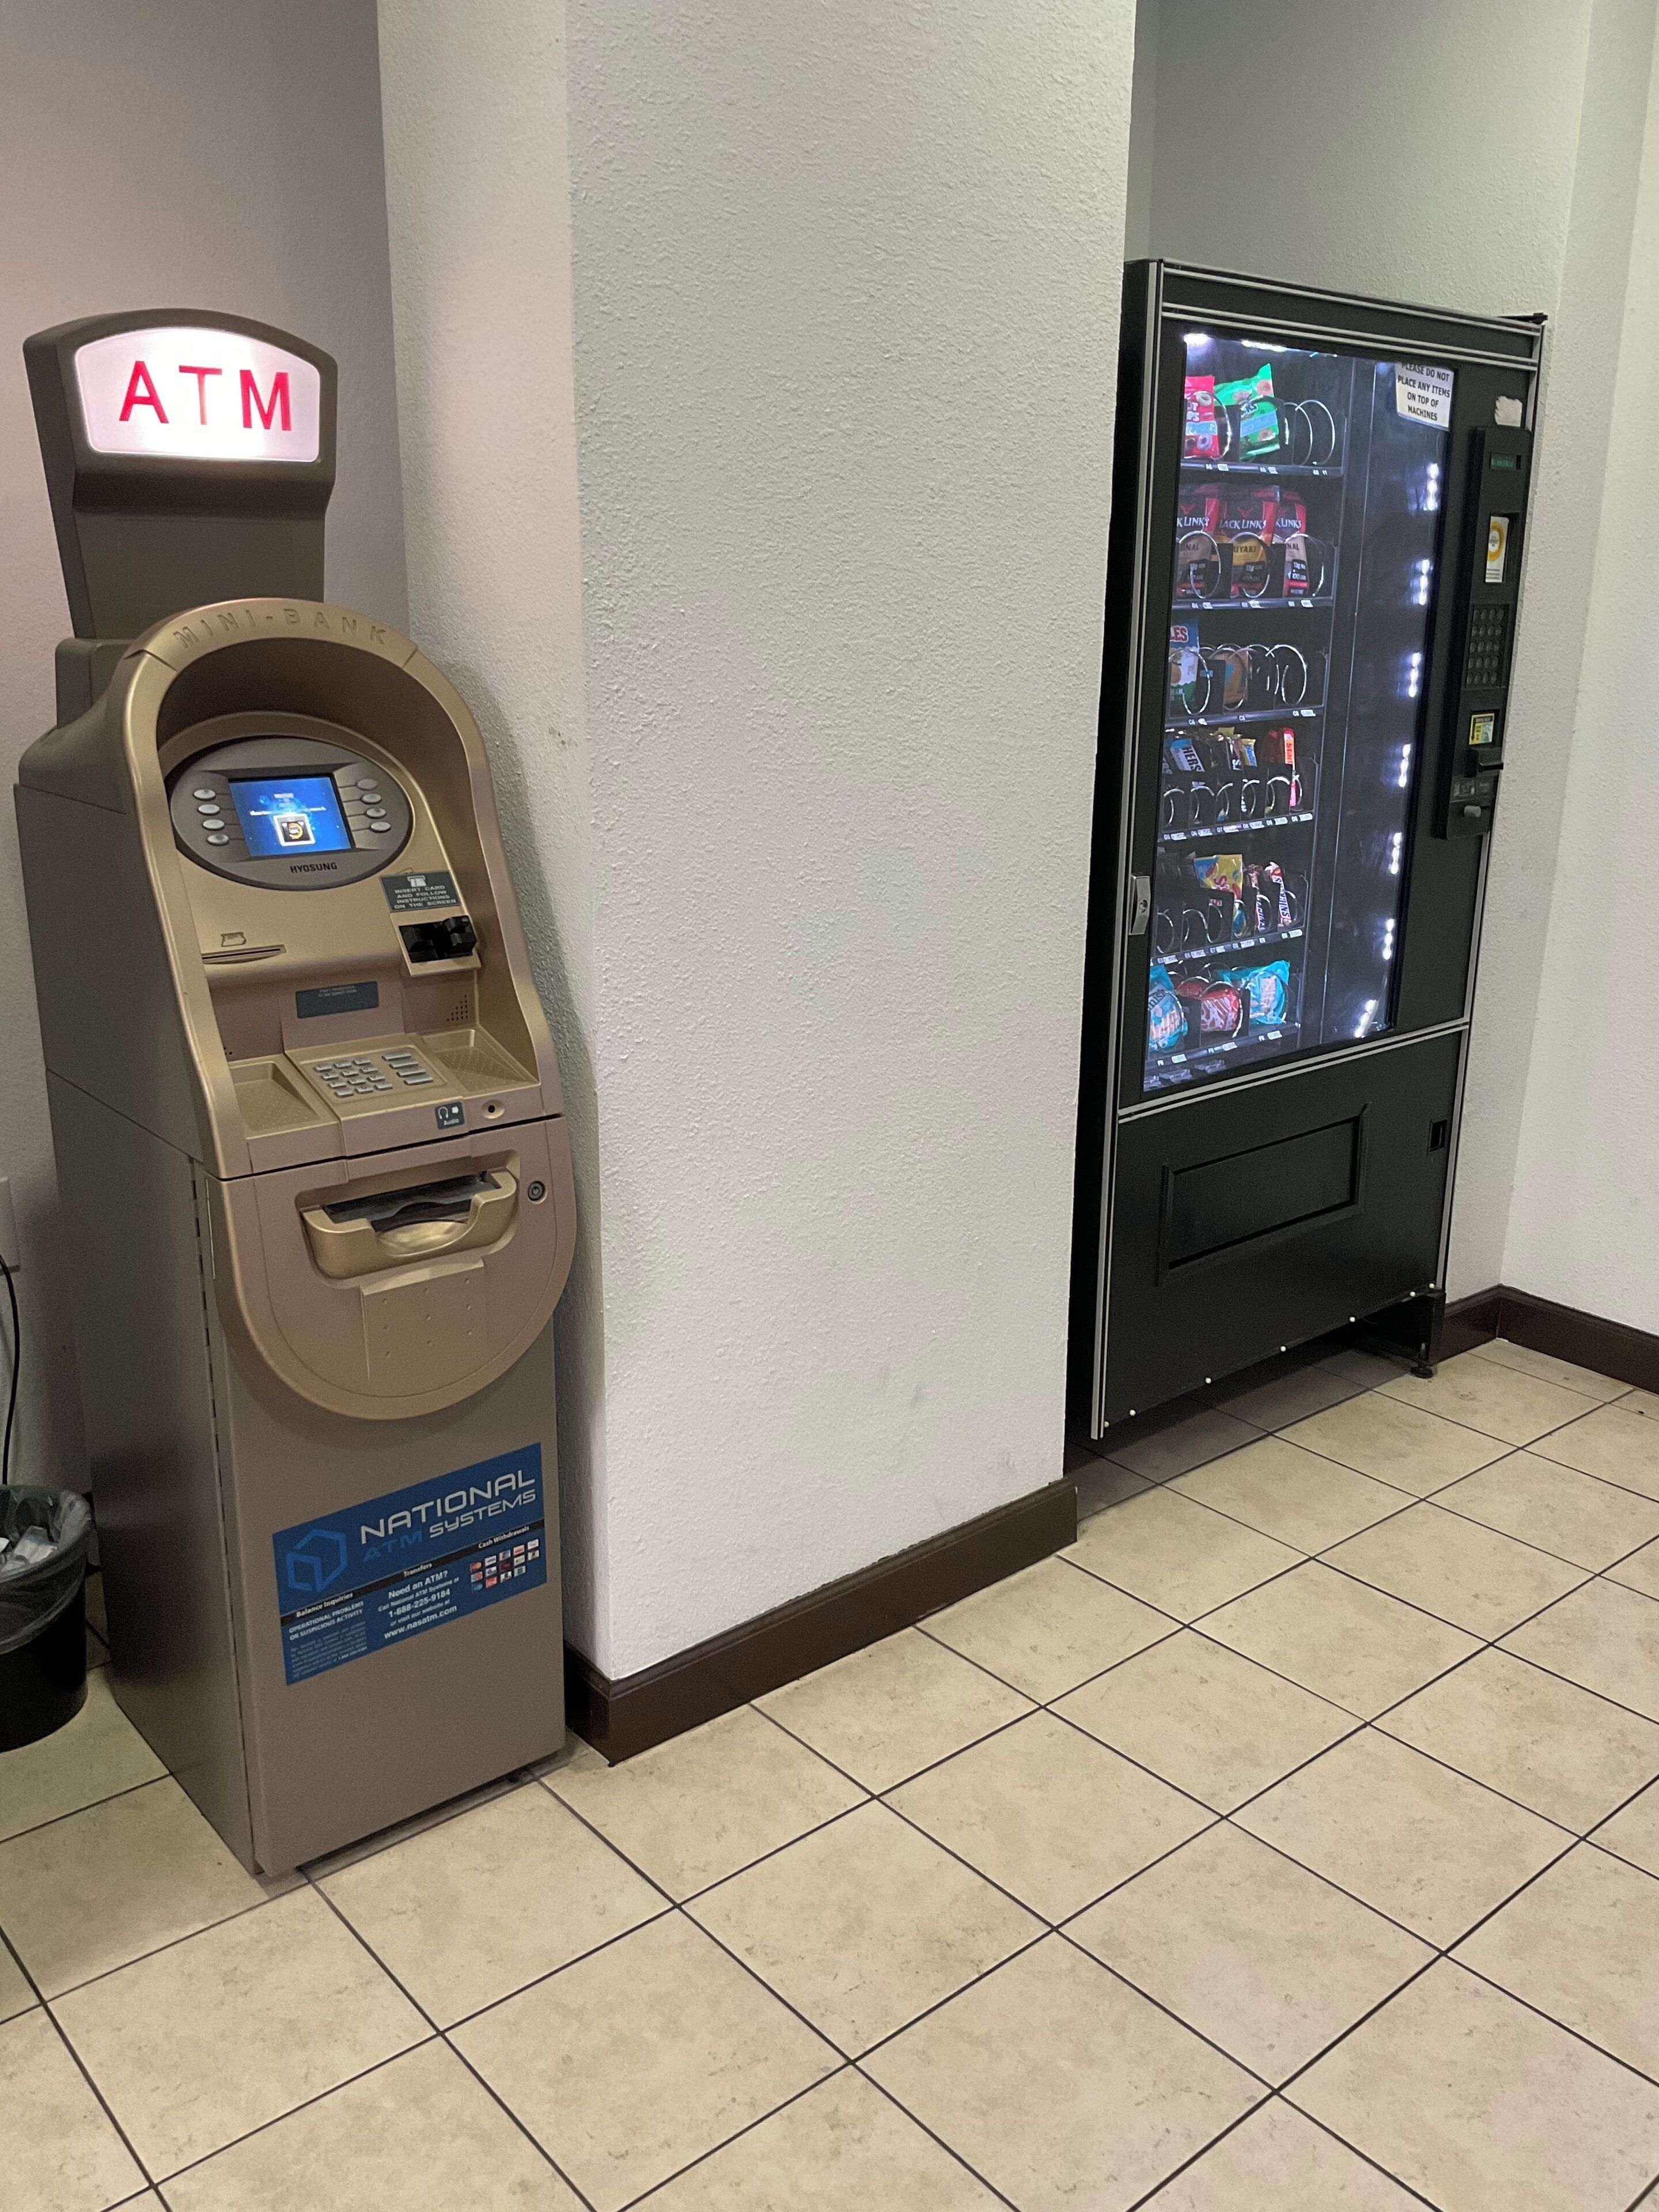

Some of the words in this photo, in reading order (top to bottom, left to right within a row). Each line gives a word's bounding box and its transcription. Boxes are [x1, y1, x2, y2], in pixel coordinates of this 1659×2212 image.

[1397, 375, 1416, 388] PLACE
[1418, 381, 1430, 392] ANY
[1432, 385, 1450, 398] ITEMS
[1402, 363, 1425, 375] PLEASE
[1426, 368, 1435, 377] DO
[1437, 370, 1450, 382] NOT
[119, 360, 292, 431] ATM
[1407, 392, 1416, 402] ON
[1418, 395, 1429, 404] TOP
[1431, 399, 1439, 408] OF
[1408, 405, 1438, 421] MACHINES
[173, 608, 387, 649] MINI-BANK
[1181, 747, 1202, 772] HERS
[290, 862, 338, 873] HYOSUNG
[396, 895, 450, 904] INSTRUCTIONS
[361, 1470, 535, 1544] NATIONAL
[363, 1530, 422, 1562] ATM
[430, 1489, 536, 1538] SYSTEMS
[296, 1604, 323, 1618] Balance
[324, 1593, 353, 1607] Inquiries
[404, 1563, 432, 1577] Transfers
[478, 1539, 493, 1548] Cash
[494, 1526, 529, 1543] Withdrawals
[388, 1585, 410, 1599] Need
[412, 1581, 423, 1589] an
[425, 1570, 448, 1585] ATM?
[378, 1603, 389, 1612] Call
[391, 1594, 414, 1606] National
[415, 1589, 427, 1597] ATM
[429, 1580, 452, 1592] Systems
[389, 1588, 450, 1618] 1-888-225-9184
[289, 1614, 331, 1633] OPERATIONAL
[332, 1601, 364, 1617] PROBLEMS
[300, 1619, 335, 1638] SUSPICIOUS
[336, 1608, 363, 1622] ACTIVITY
[384, 1605, 457, 1639] www.nasatm.com
[398, 1615, 410, 1623] visit
[422, 1602, 444, 1613] website
